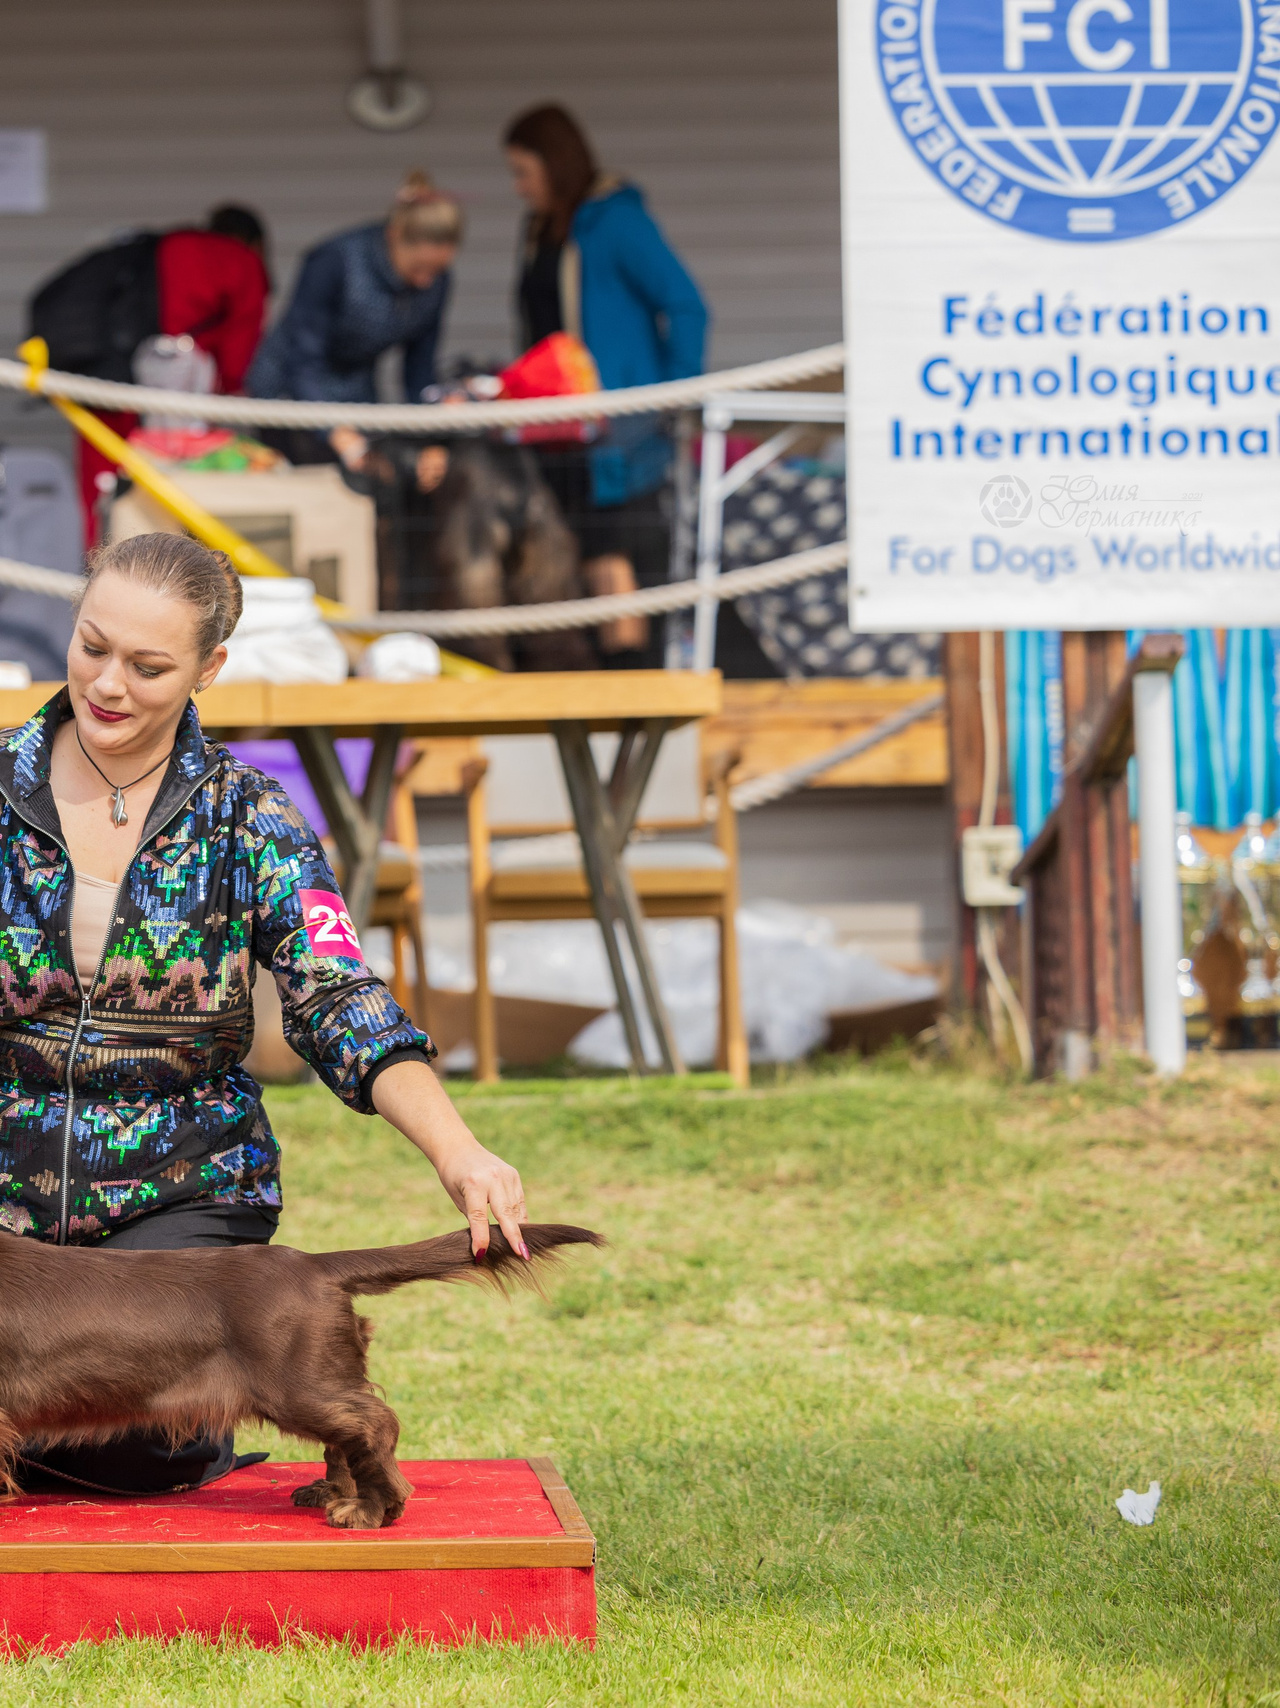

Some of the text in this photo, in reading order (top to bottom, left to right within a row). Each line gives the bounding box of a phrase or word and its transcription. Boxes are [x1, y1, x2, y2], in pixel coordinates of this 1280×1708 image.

[1004, 0, 1171, 71] FCI
[879, 0, 1023, 221] FEDERATIO
[1157, 0, 1280, 220] NATIONALE
[943, 292, 1270, 335] Fédération
[921, 353, 1280, 409] Cynologique
[888, 535, 956, 574] For
[971, 534, 1077, 583] Dogs
